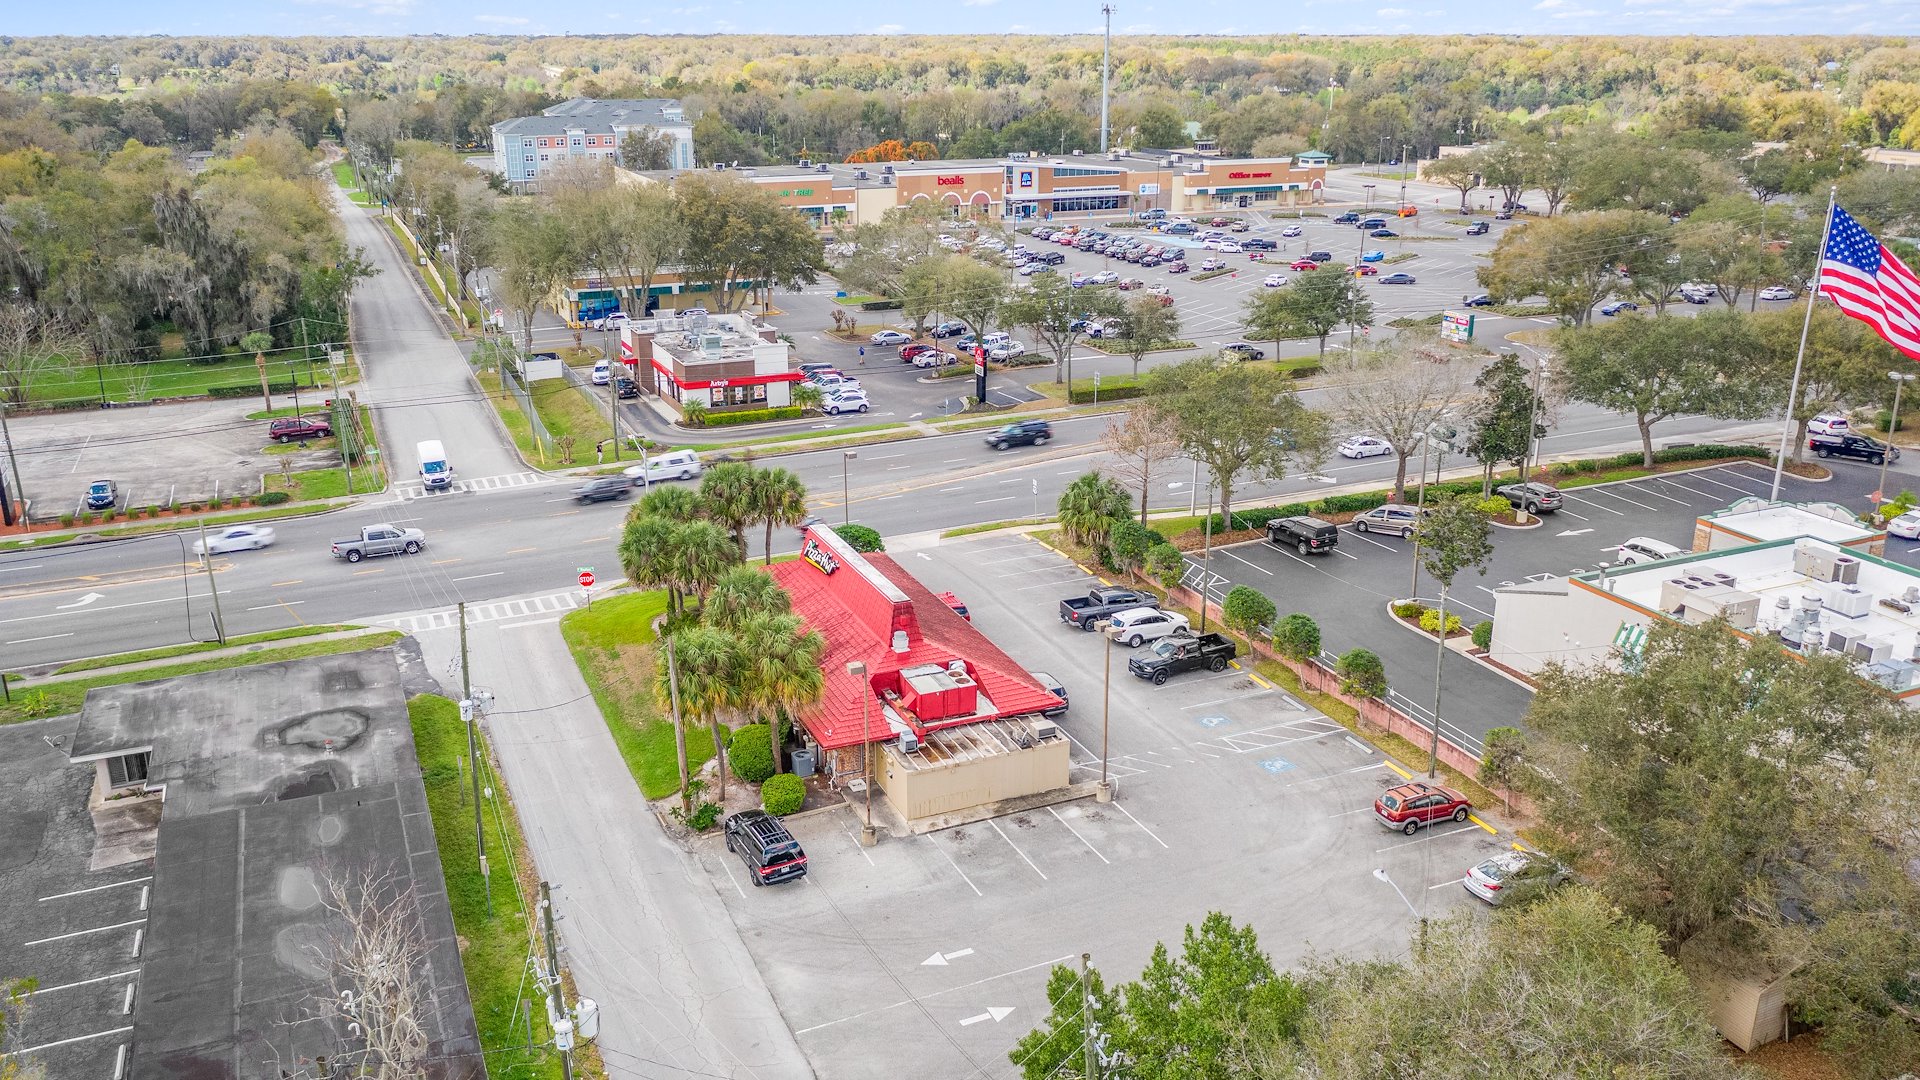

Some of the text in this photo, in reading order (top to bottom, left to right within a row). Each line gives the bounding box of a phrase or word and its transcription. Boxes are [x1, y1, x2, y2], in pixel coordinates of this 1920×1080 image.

[937, 175, 965, 186] bealls
[710, 379, 729, 388] Arby's
[804, 539, 822, 562] Pizza
